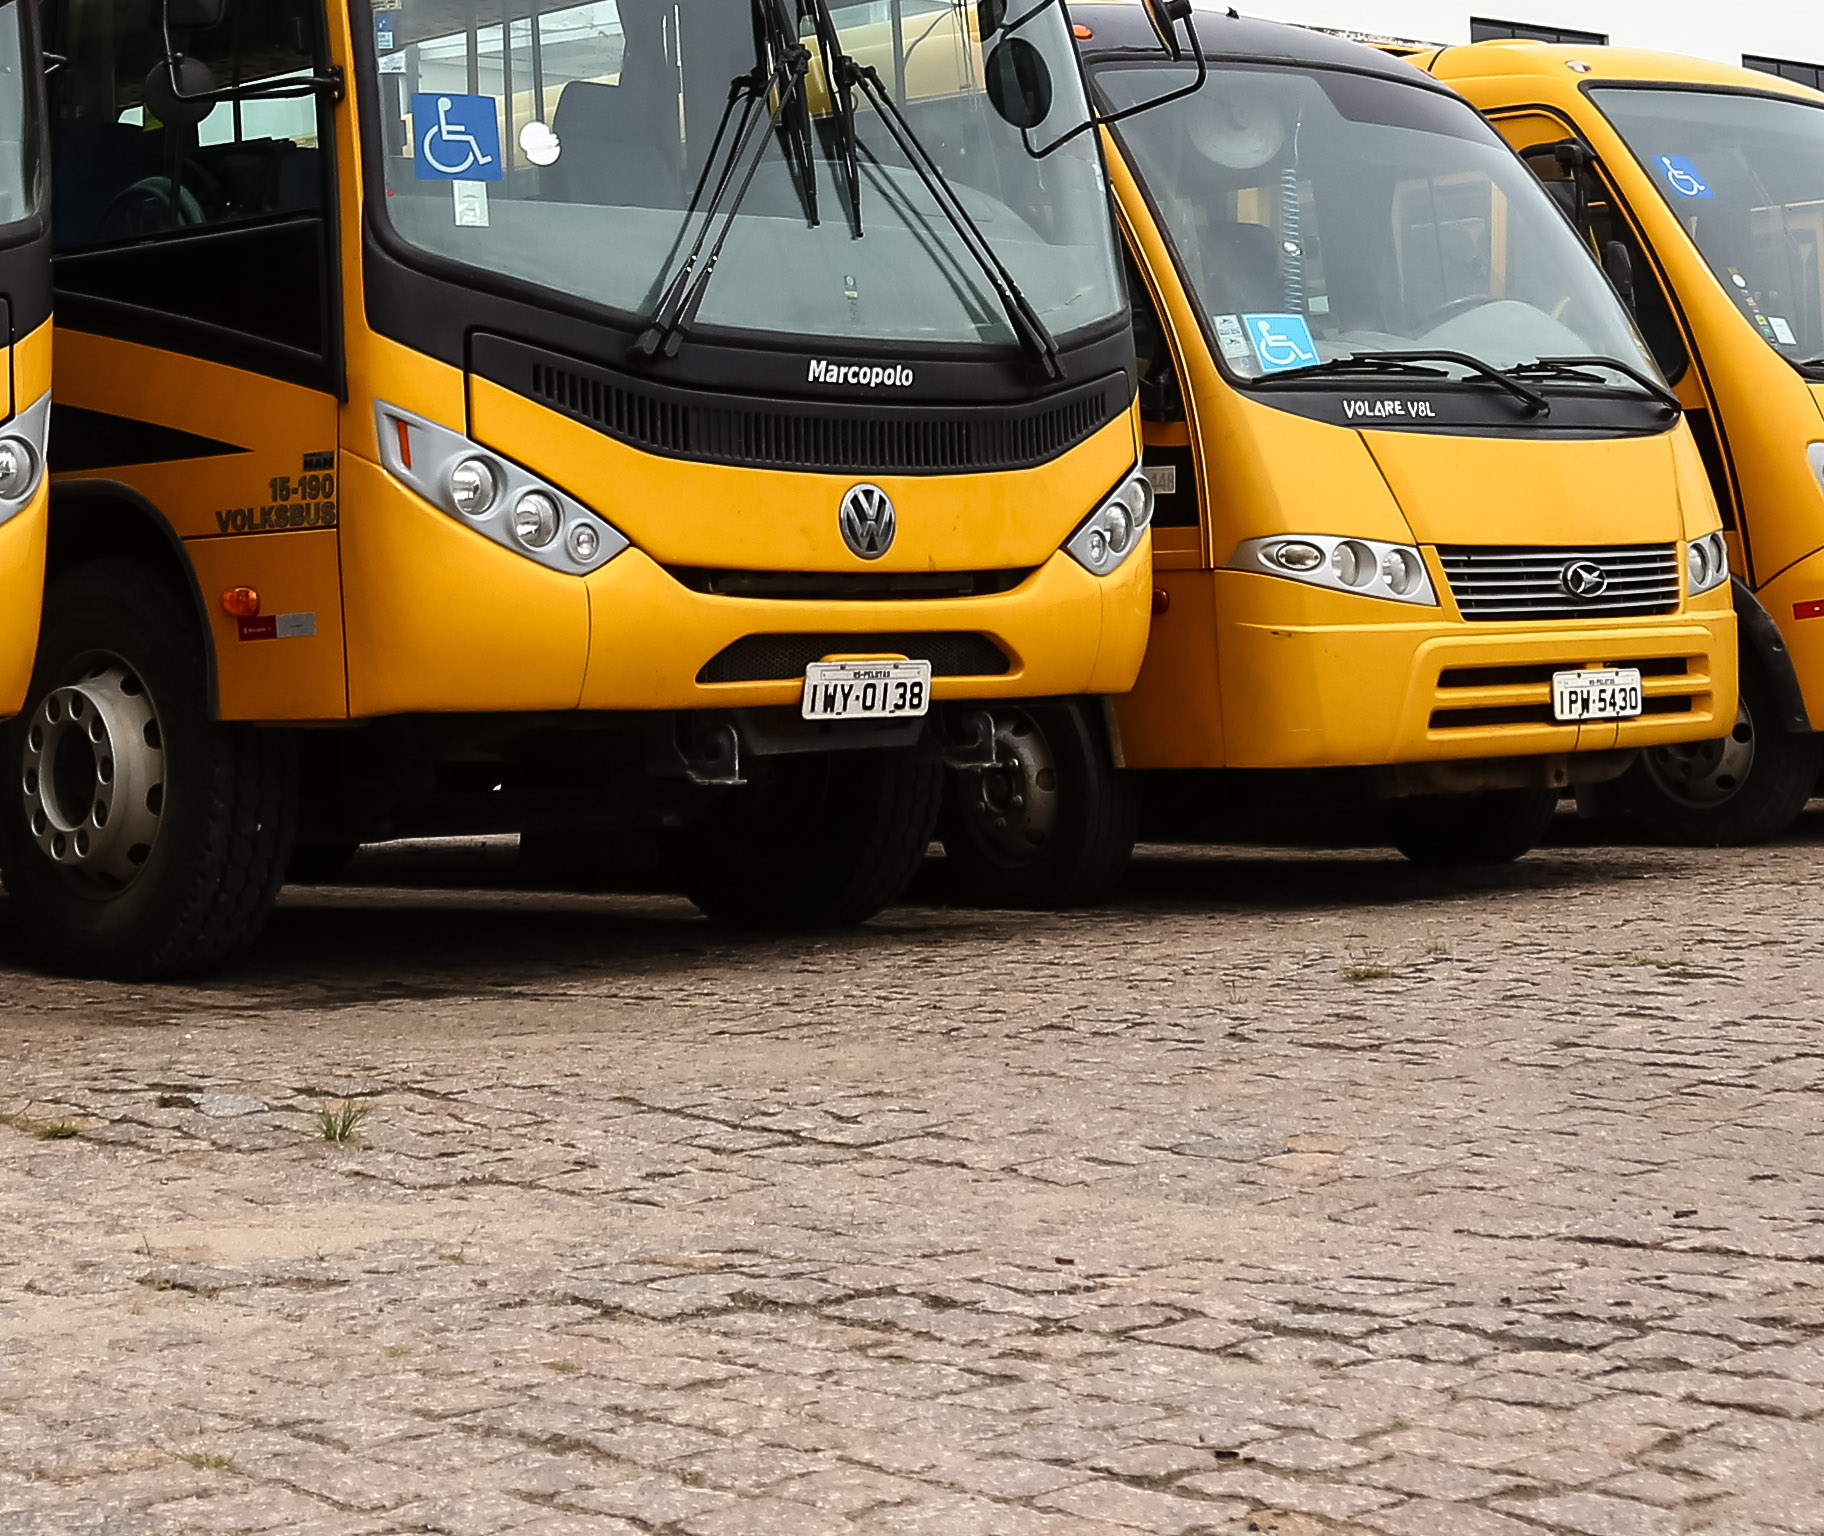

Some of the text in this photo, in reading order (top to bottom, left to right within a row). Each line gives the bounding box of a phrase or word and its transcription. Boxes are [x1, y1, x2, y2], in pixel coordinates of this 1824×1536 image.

[807, 359, 914, 388] Marcopolo
[1342, 399, 1436, 419] VOLARE V8L
[269, 472, 335, 503] 15-190
[215, 501, 336, 534] VOLKSBUS
